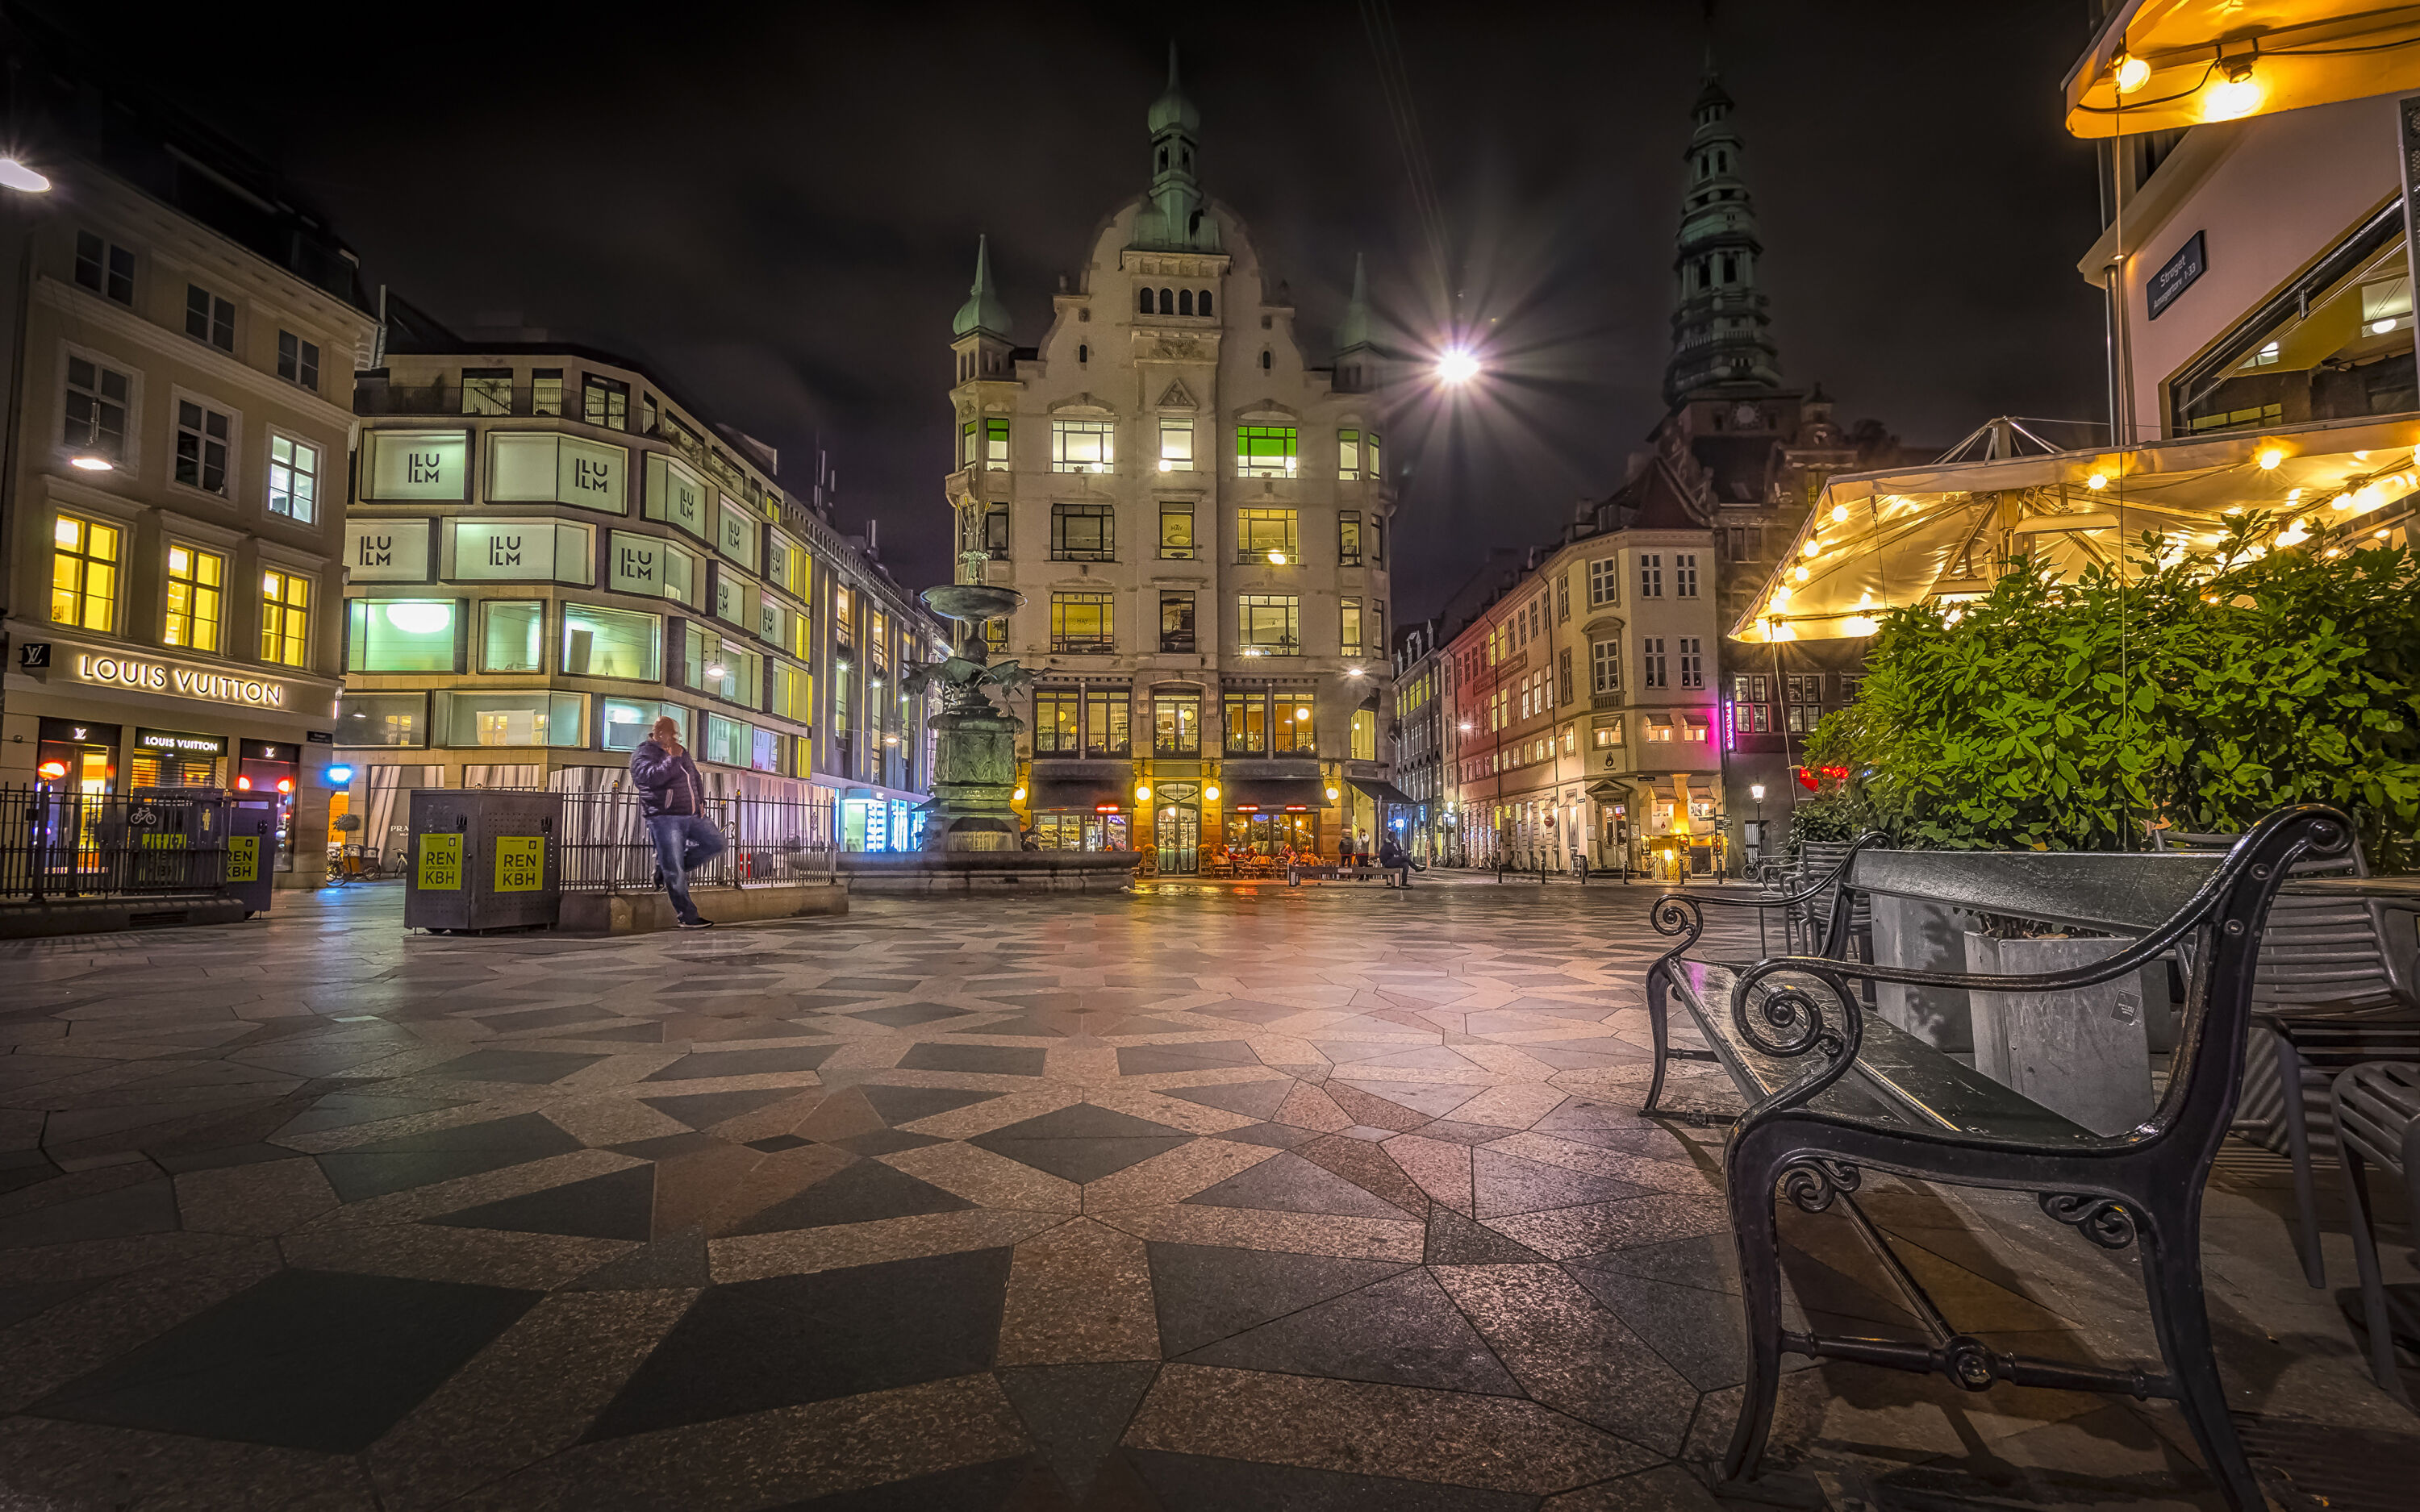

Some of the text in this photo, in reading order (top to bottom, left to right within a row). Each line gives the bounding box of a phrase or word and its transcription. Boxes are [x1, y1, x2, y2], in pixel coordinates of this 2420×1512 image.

[83, 655, 281, 706] LOUIS VUITTON
[144, 735, 218, 751] LOUIS VUITTON
[426, 852, 456, 865] REN
[503, 854, 536, 867] REN
[425, 871, 454, 884] KBH
[503, 873, 536, 885] KBH
